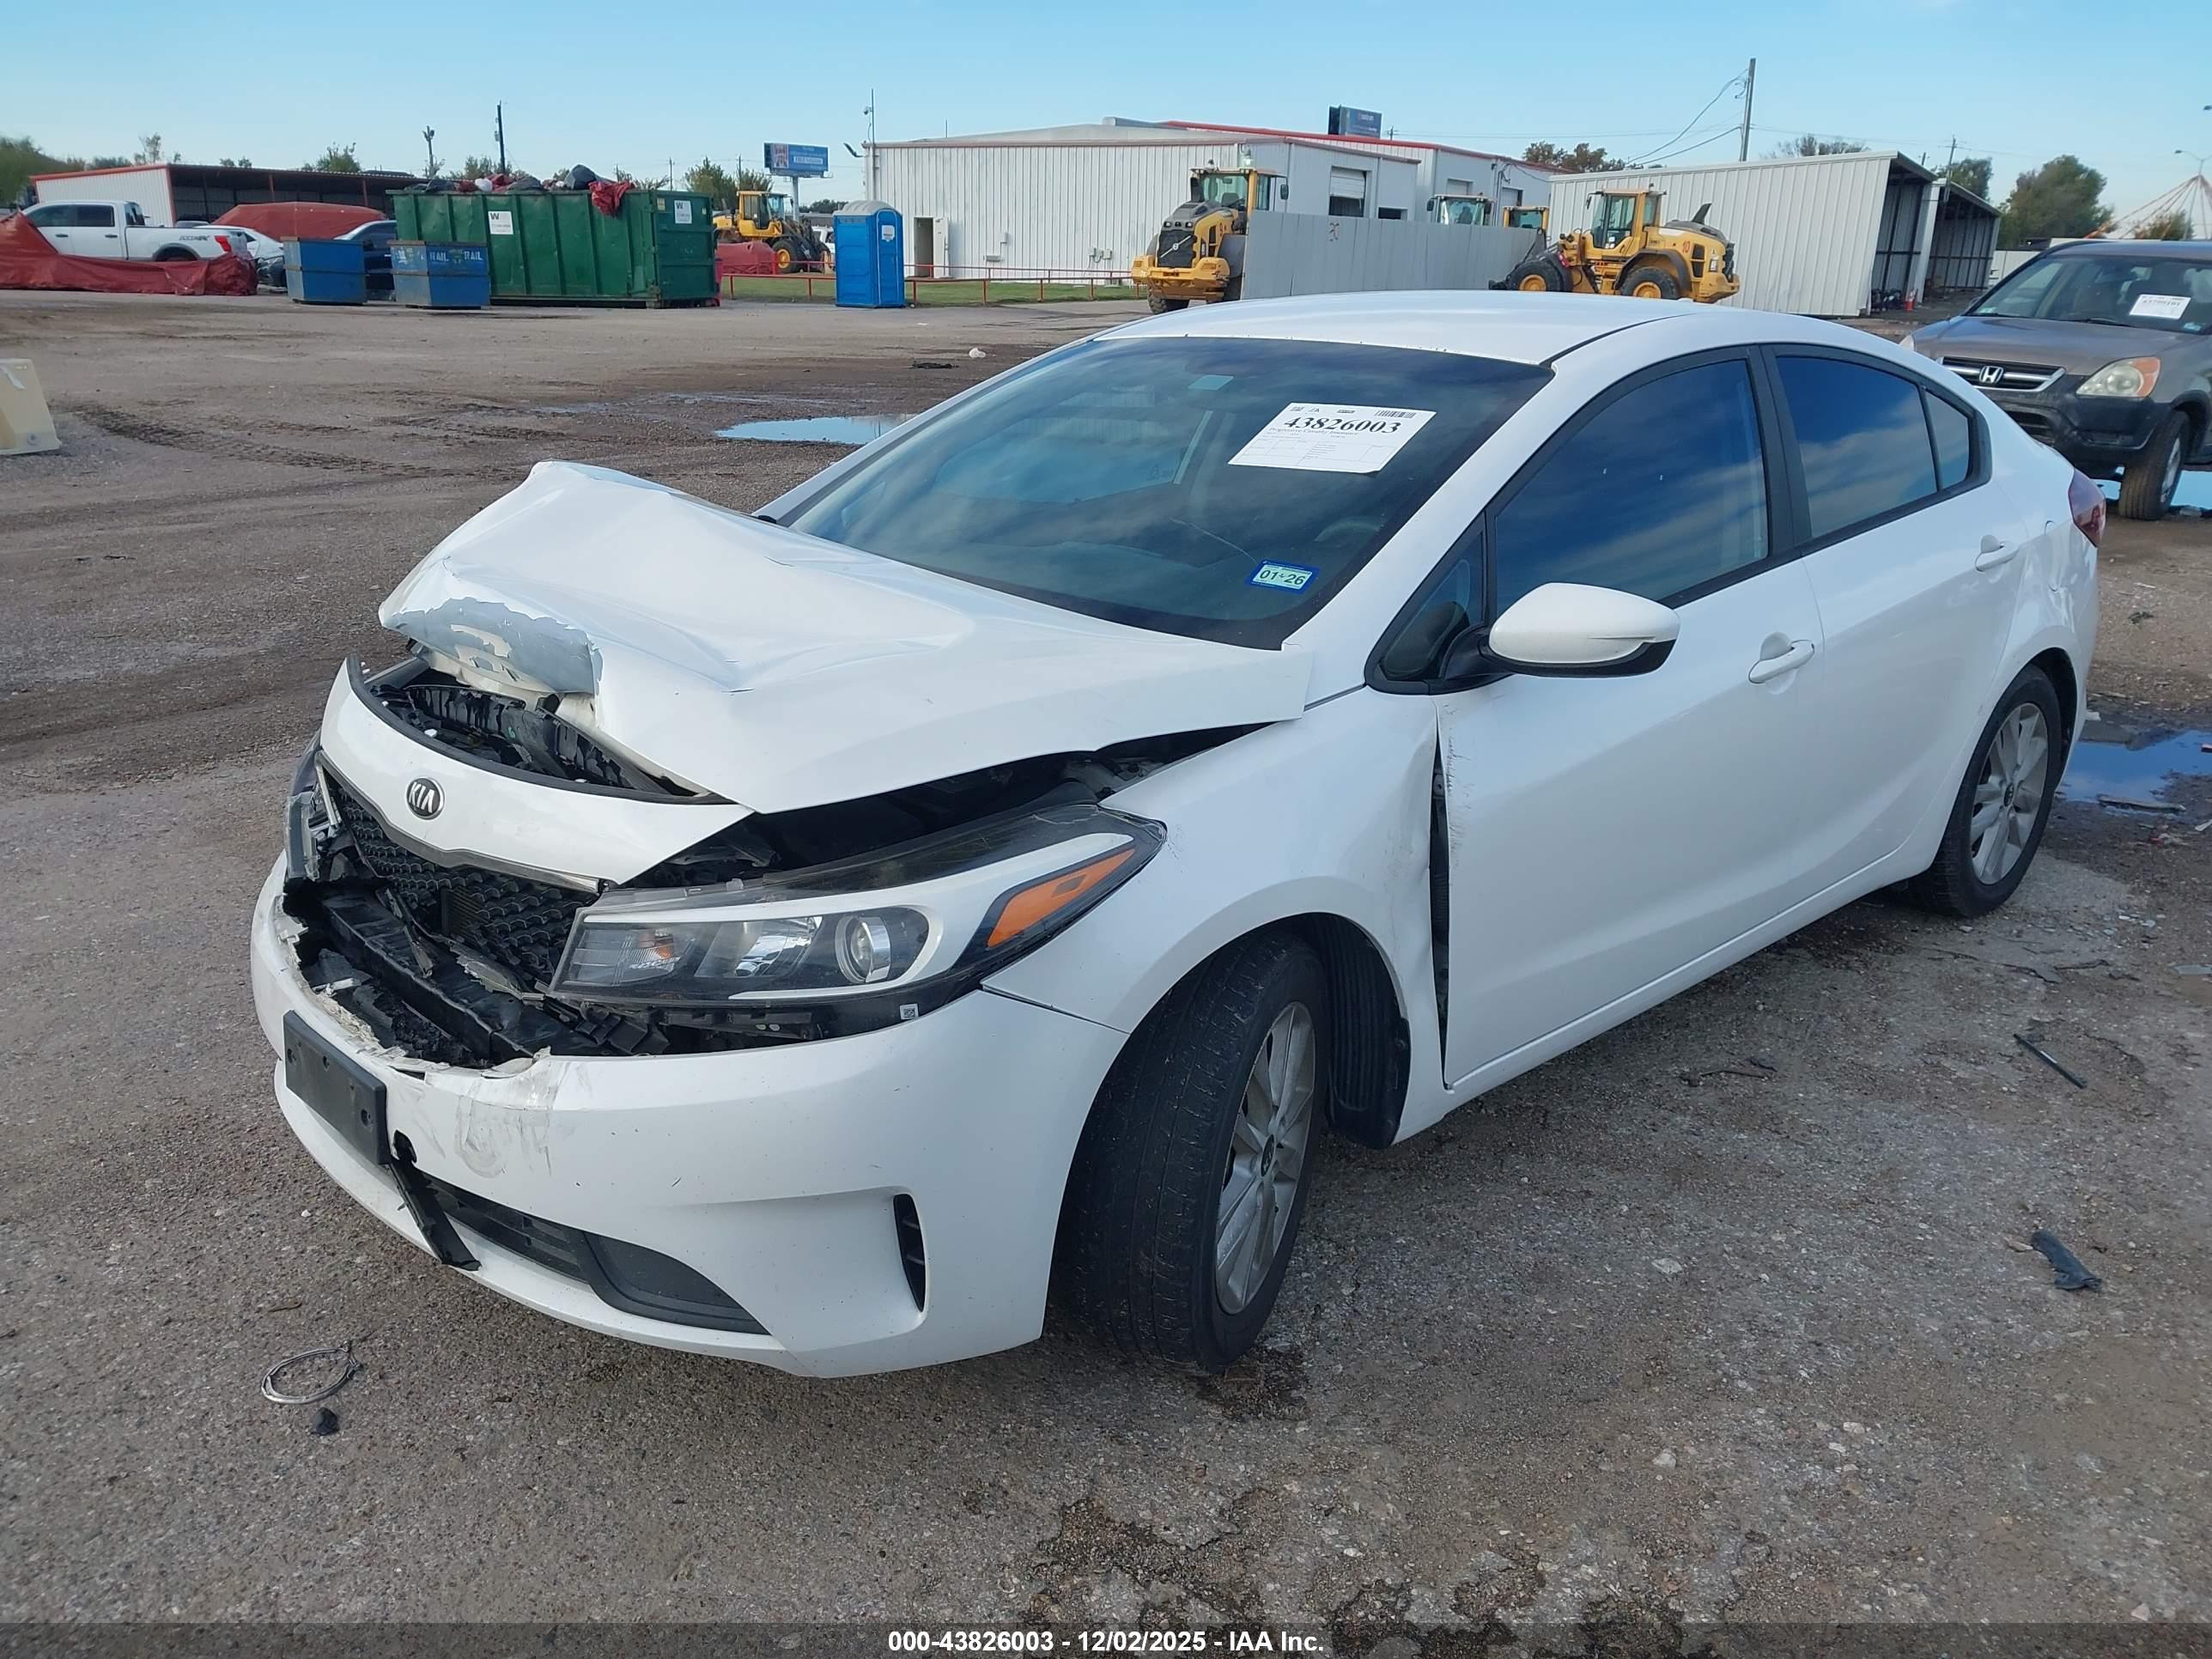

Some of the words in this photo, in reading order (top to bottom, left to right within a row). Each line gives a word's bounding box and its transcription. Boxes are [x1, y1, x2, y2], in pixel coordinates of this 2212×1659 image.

[1285, 416, 1401, 434] 43826003
[1259, 569, 1279, 580] 01
[1284, 574, 1306, 585] 26
[408, 781, 435, 813] KIA
